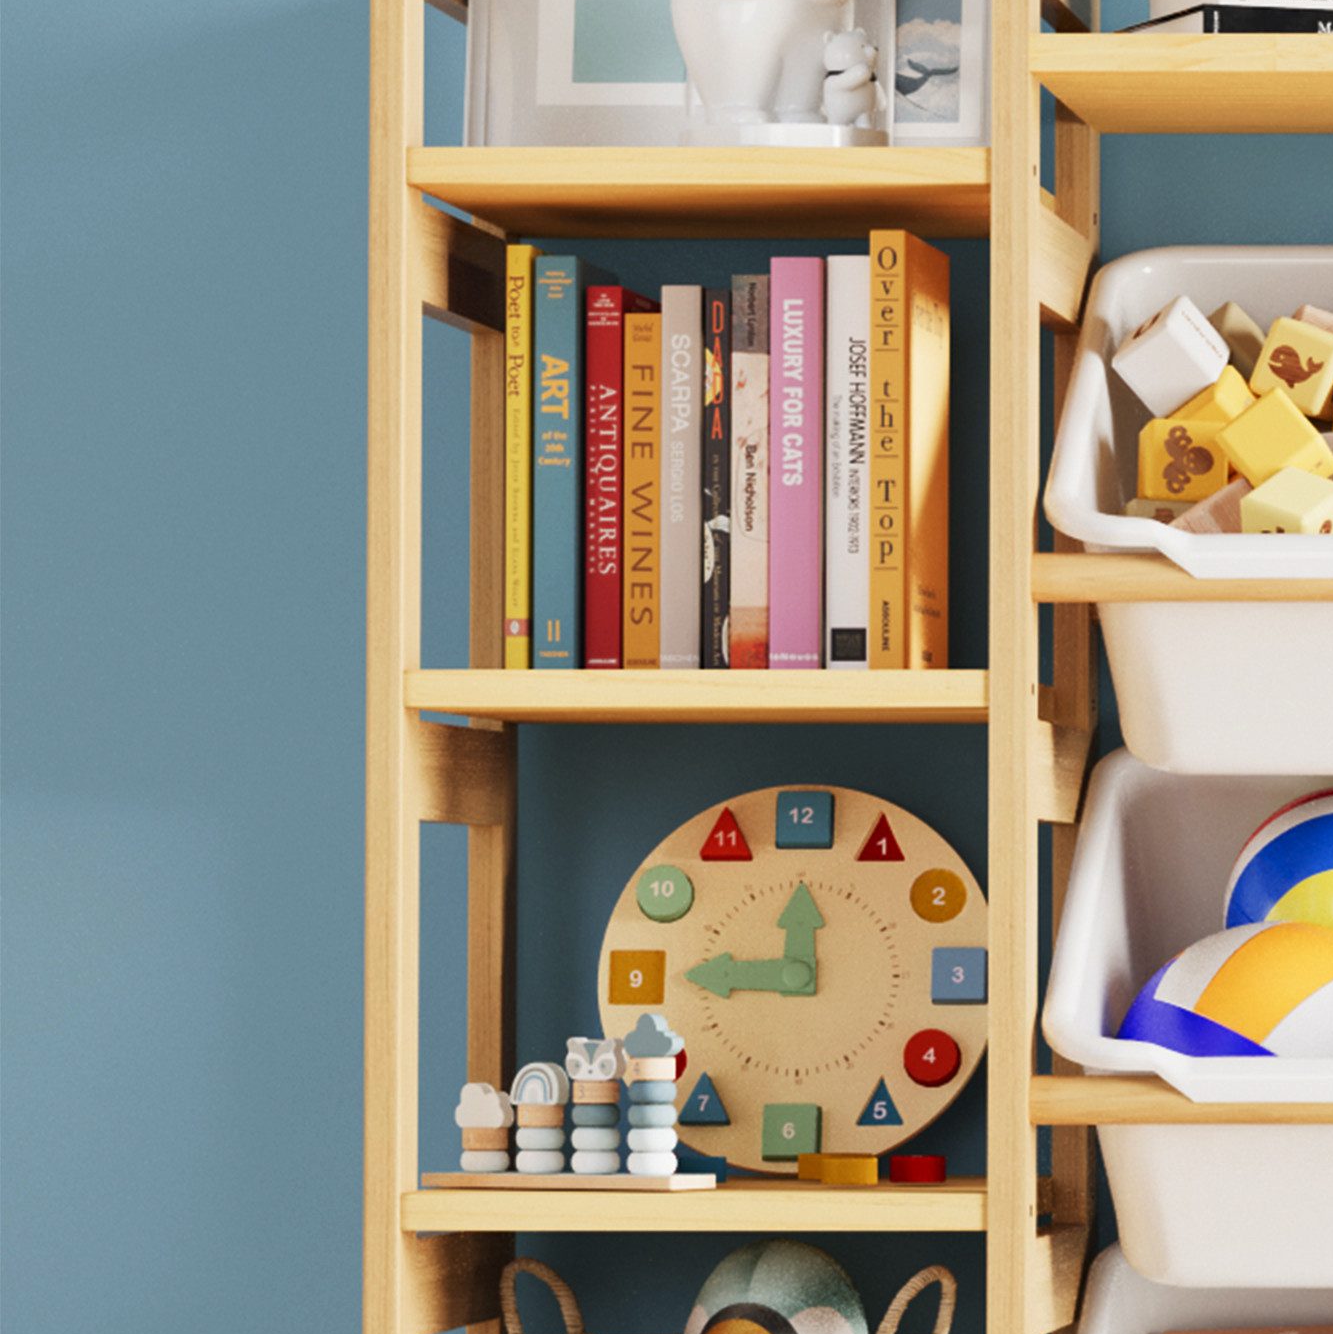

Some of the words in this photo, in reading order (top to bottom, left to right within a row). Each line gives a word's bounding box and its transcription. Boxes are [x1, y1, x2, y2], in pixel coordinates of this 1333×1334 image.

[508, 275, 525, 319] Poet
[781, 298, 804, 381] LUXURY
[848, 337, 866, 378] JOSEF
[508, 354, 525, 397] Poet
[541, 353, 570, 420] ART
[671, 333, 691, 433] SCARPA
[711, 300, 724, 440] DADA
[631, 364, 654, 459] FINE
[781, 386, 804, 429] FOR
[848, 382, 866, 465] HOFFMANN
[538, 457, 570, 469] Century
[669, 441, 684, 492] SERGIO
[744, 444, 757, 468] Ben
[781, 439, 804, 486] CATS
[597, 384, 618, 576] ANTIQUAIRES
[669, 496, 684, 523] LOS
[744, 472, 757, 532] Nicholson
[630, 482, 653, 625] WINES
[789, 807, 814, 824] 12
[713, 830, 737, 847] 11
[876, 838, 889, 855] 1
[650, 880, 675, 898] 10
[932, 887, 946, 906] 2
[629, 969, 644, 988] 9
[951, 967, 965, 984] 3
[922, 1048, 936, 1064] 4
[698, 1094, 710, 1111] 7
[873, 1101, 888, 1120] 5
[782, 1122, 796, 1139] 6
